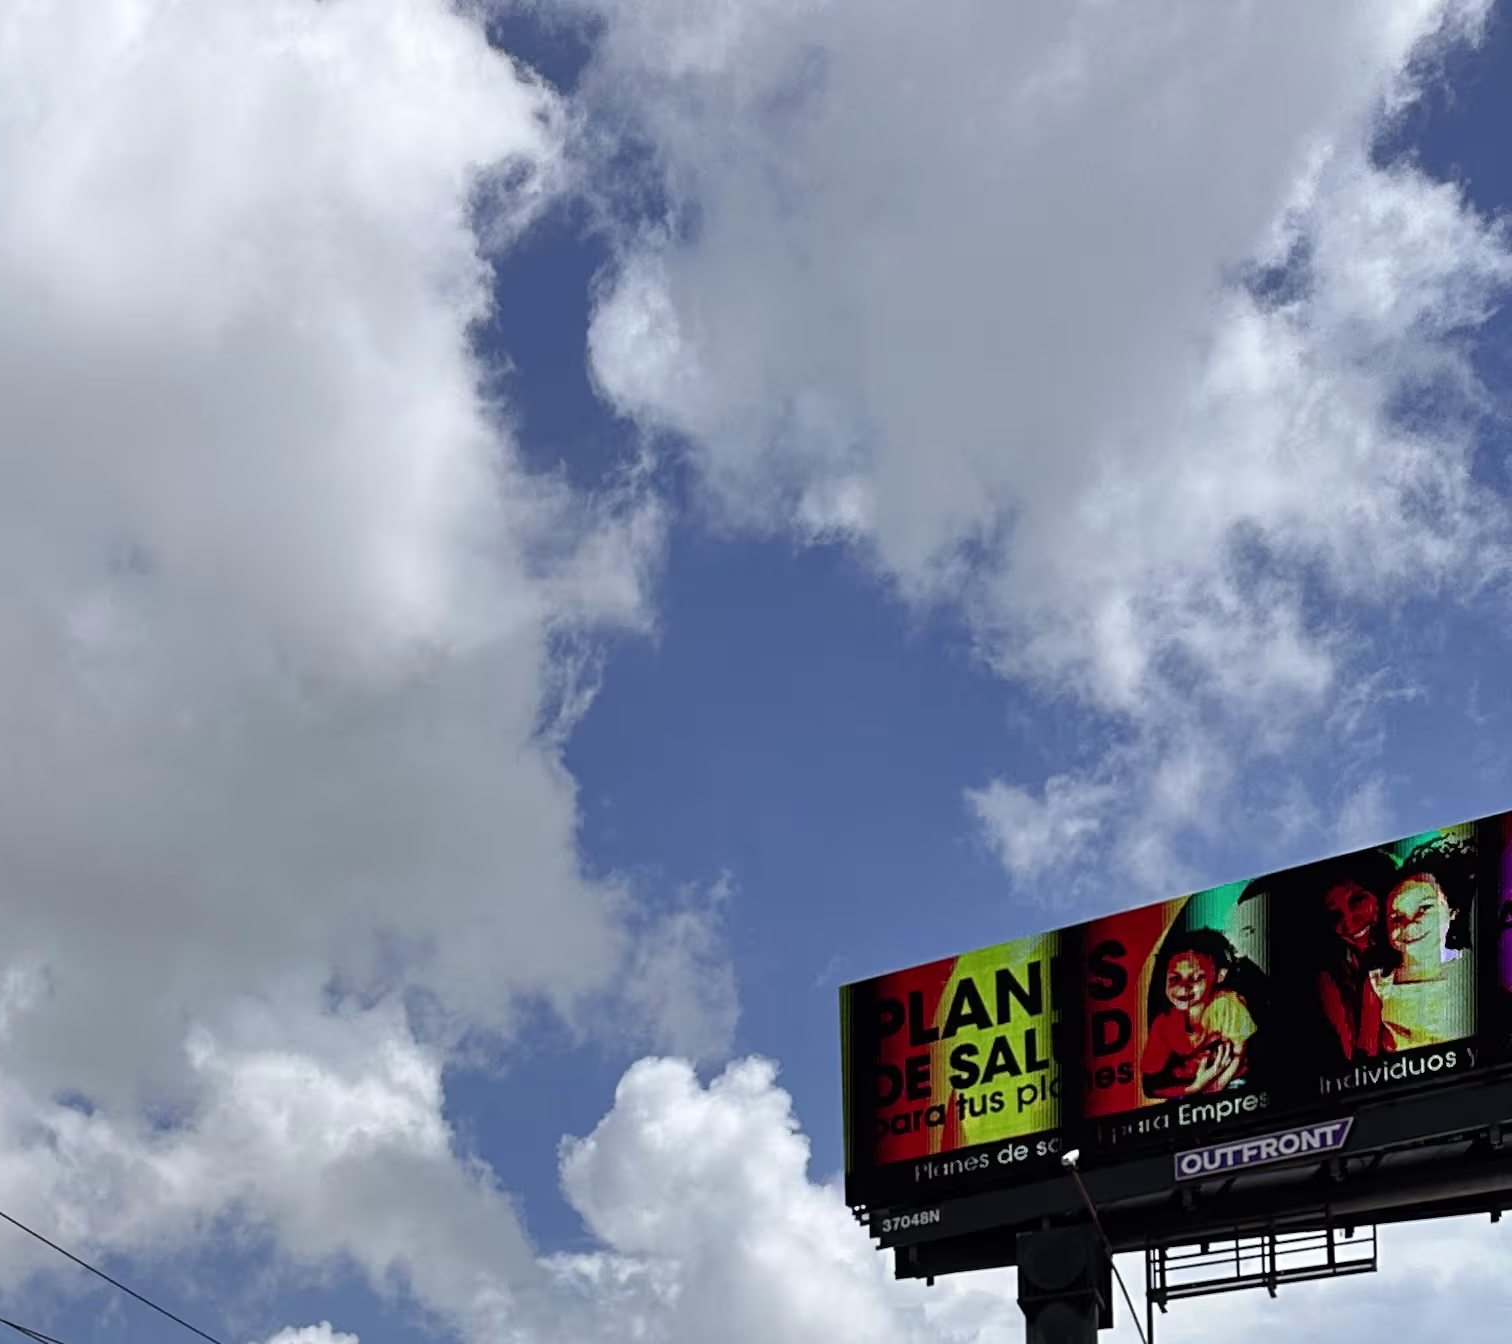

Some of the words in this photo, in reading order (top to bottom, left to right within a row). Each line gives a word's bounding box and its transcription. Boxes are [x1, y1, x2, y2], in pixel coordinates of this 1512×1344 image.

[874, 1053, 931, 1107] DE
[955, 1091, 1004, 1121] tus
[997, 1144, 1029, 1165] de
[1178, 1091, 1268, 1126] Empres
[1320, 1050, 1457, 1095] Individuos
[1181, 1123, 1341, 1174] OUTFRONT
[882, 1209, 940, 1232] 37048N
